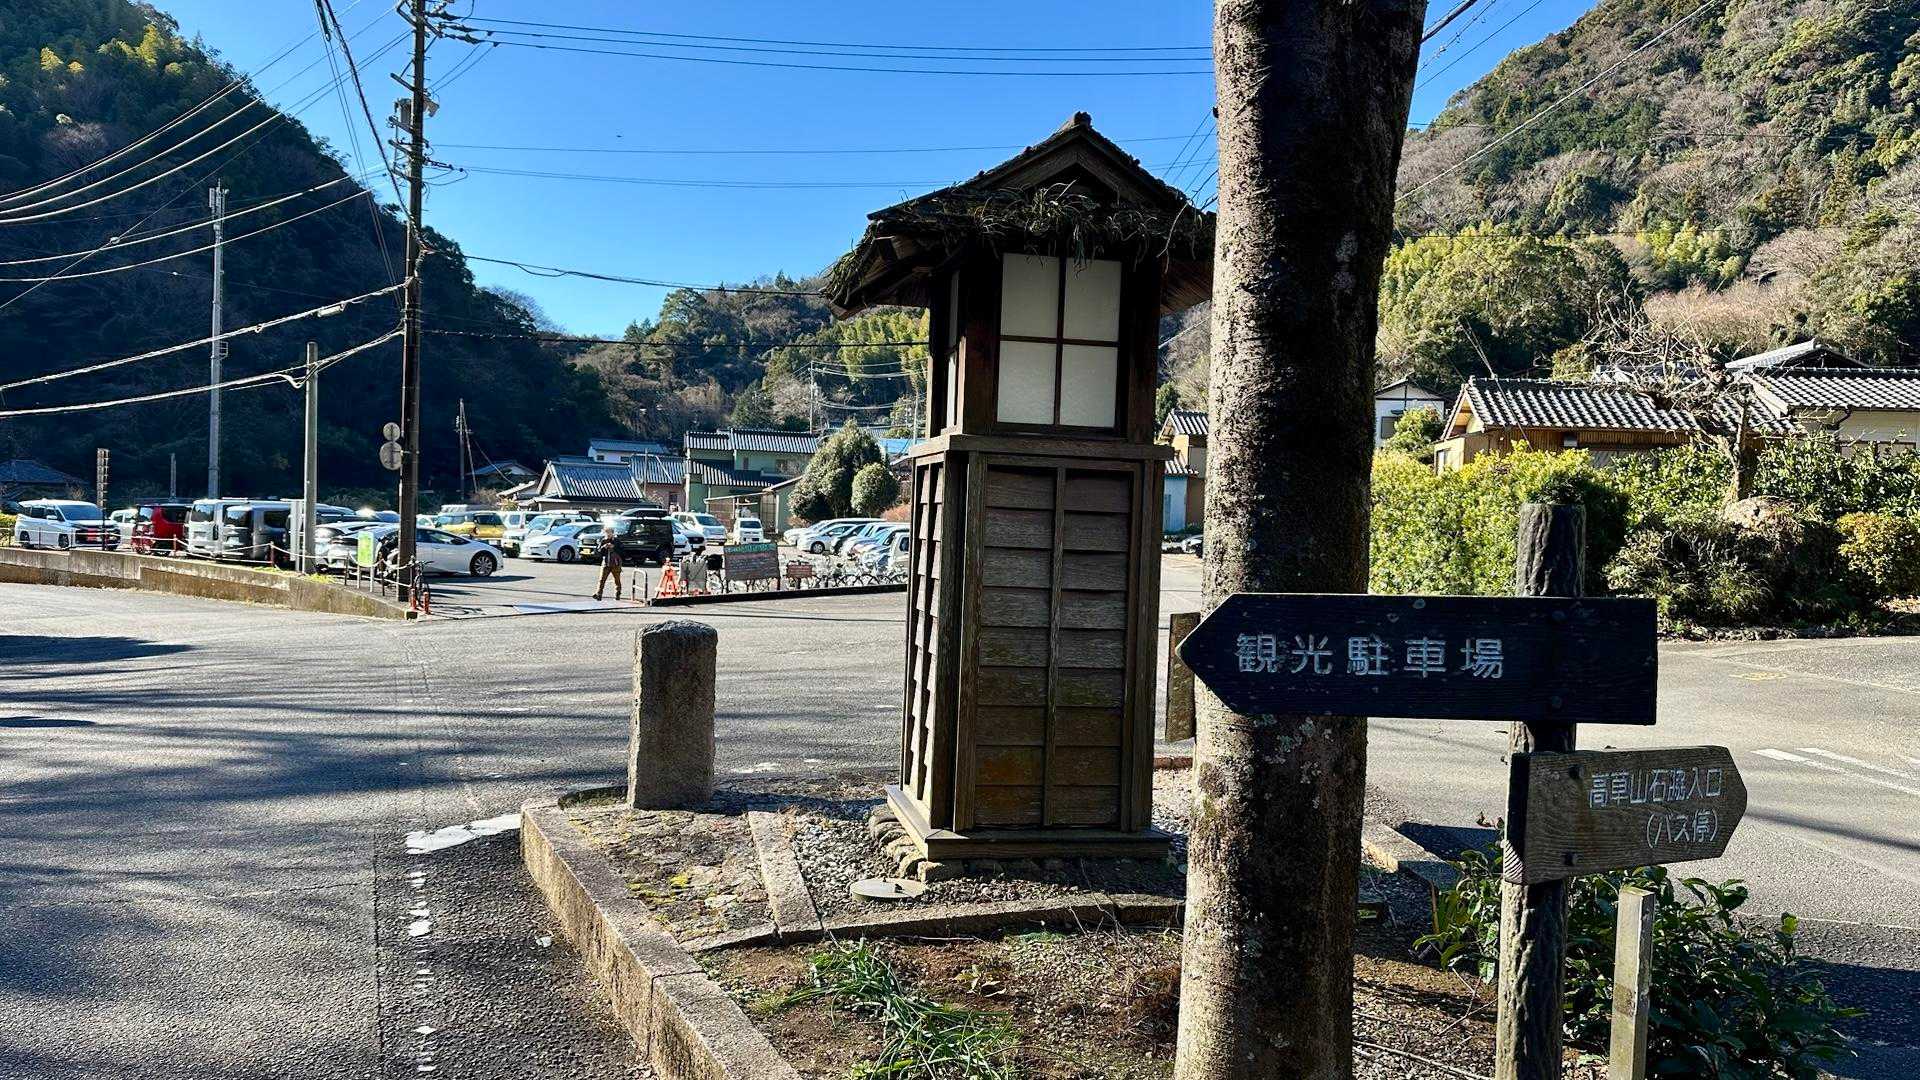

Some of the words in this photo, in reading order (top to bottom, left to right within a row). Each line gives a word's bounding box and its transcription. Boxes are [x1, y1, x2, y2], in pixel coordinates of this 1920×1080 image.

[1235, 633, 1504, 679] 観光駐車場
[1588, 766, 1721, 808] 高草山石脇入口
[1646, 807, 1718, 848] (バス停)
